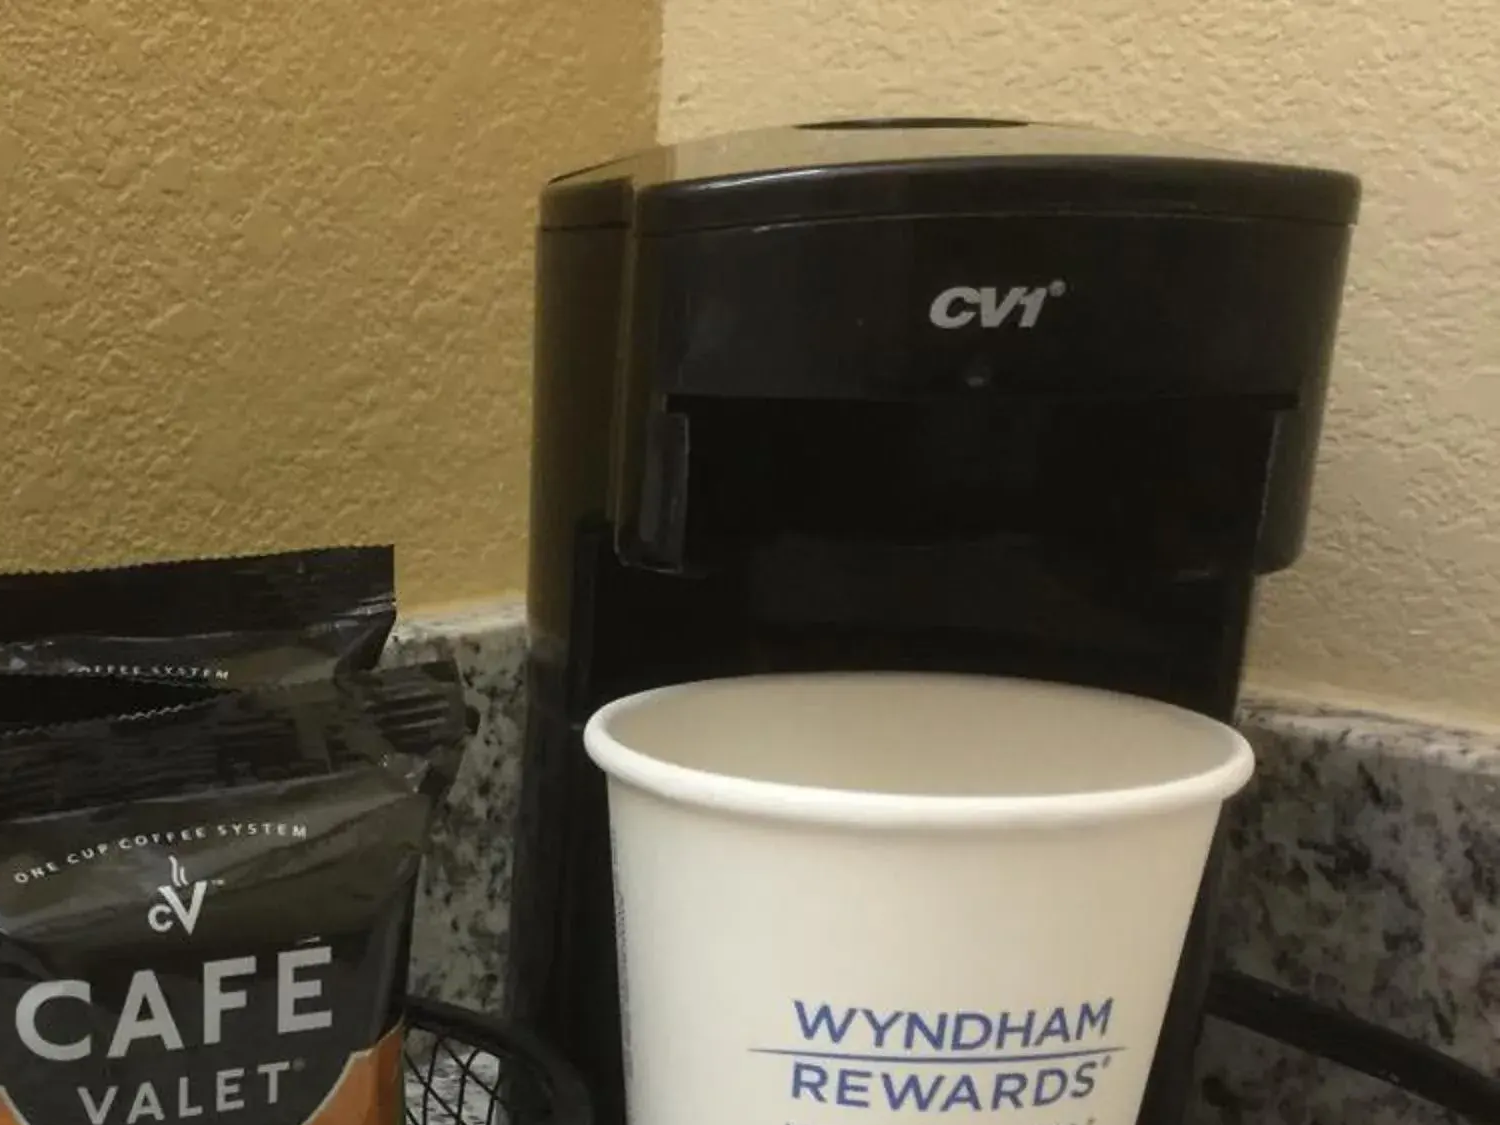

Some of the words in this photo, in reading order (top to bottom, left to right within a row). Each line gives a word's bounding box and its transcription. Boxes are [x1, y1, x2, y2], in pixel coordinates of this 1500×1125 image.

[13, 861, 59, 884] ONE
[66, 843, 108, 865] CUP
[117, 826, 208, 850] COFFEE
[216, 822, 308, 840] SYSTEM
[14, 936, 333, 1061] CAFÉ
[792, 997, 1115, 1052] WYNDHAM
[791, 1060, 1098, 1112] REWARDS
